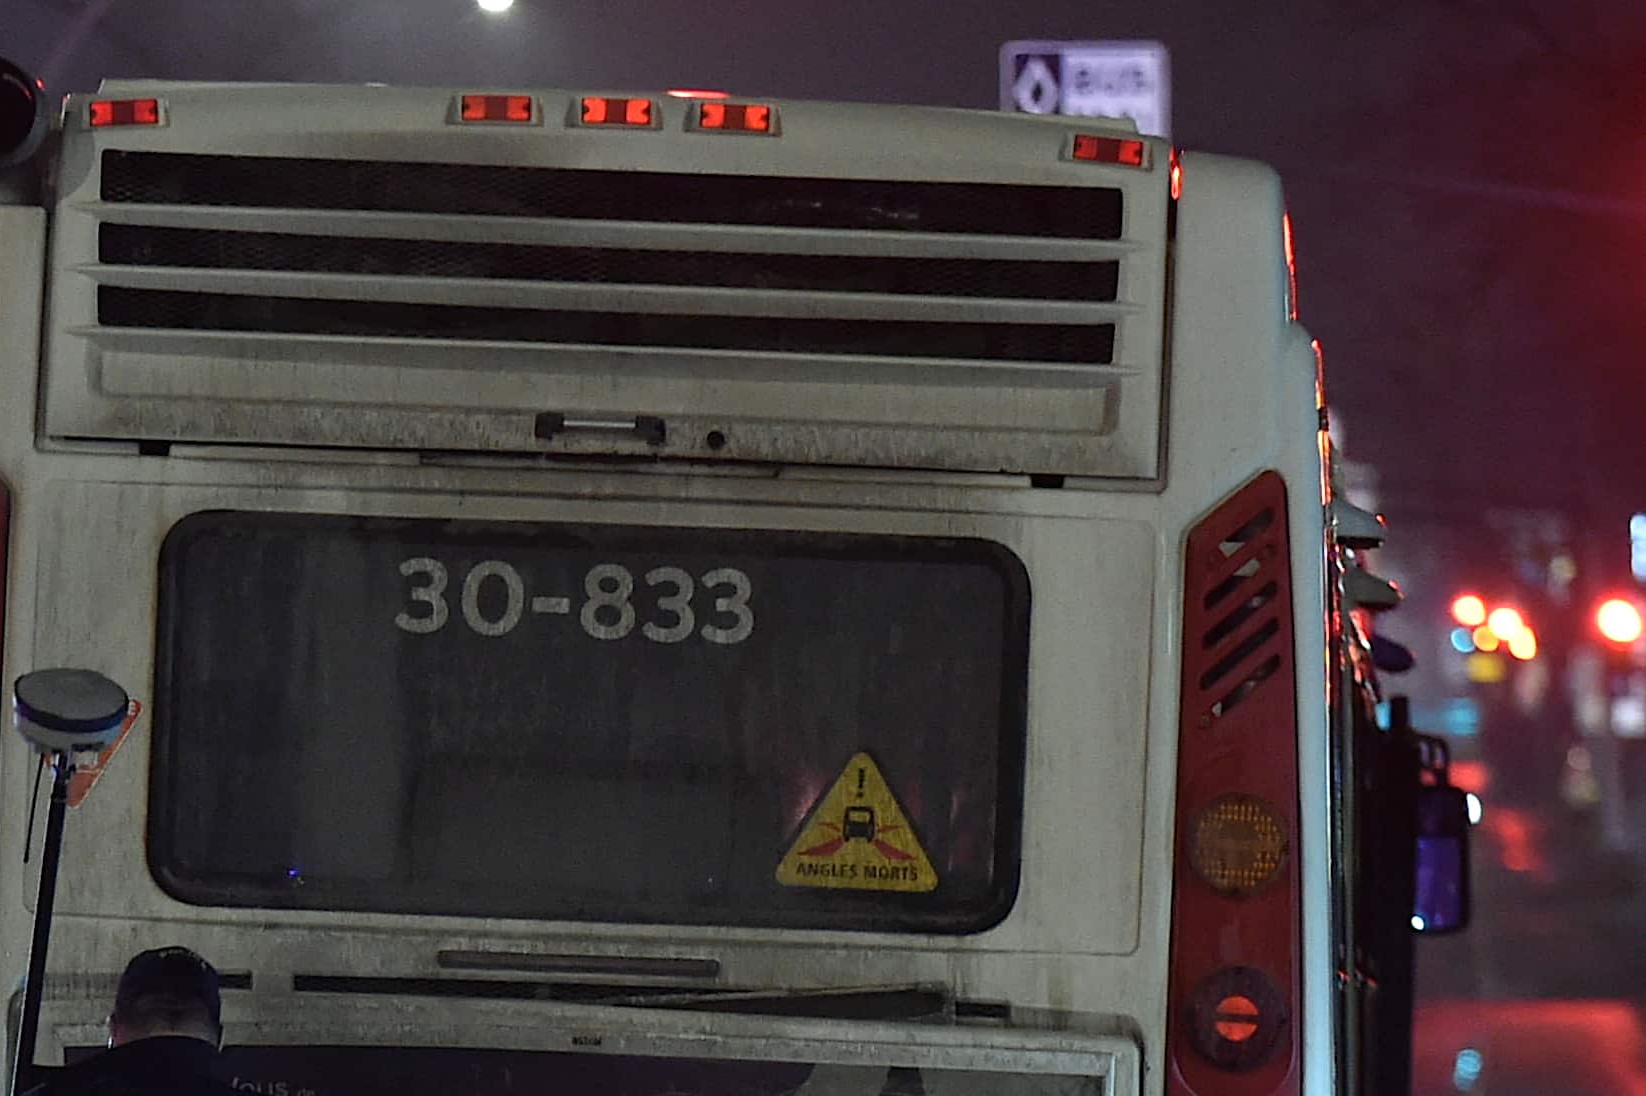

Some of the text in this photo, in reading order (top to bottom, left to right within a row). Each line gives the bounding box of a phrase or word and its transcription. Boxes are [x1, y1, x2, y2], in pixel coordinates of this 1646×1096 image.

[395, 558, 754, 644] 30-833
[796, 862, 919, 881] ANGLES MORTS
